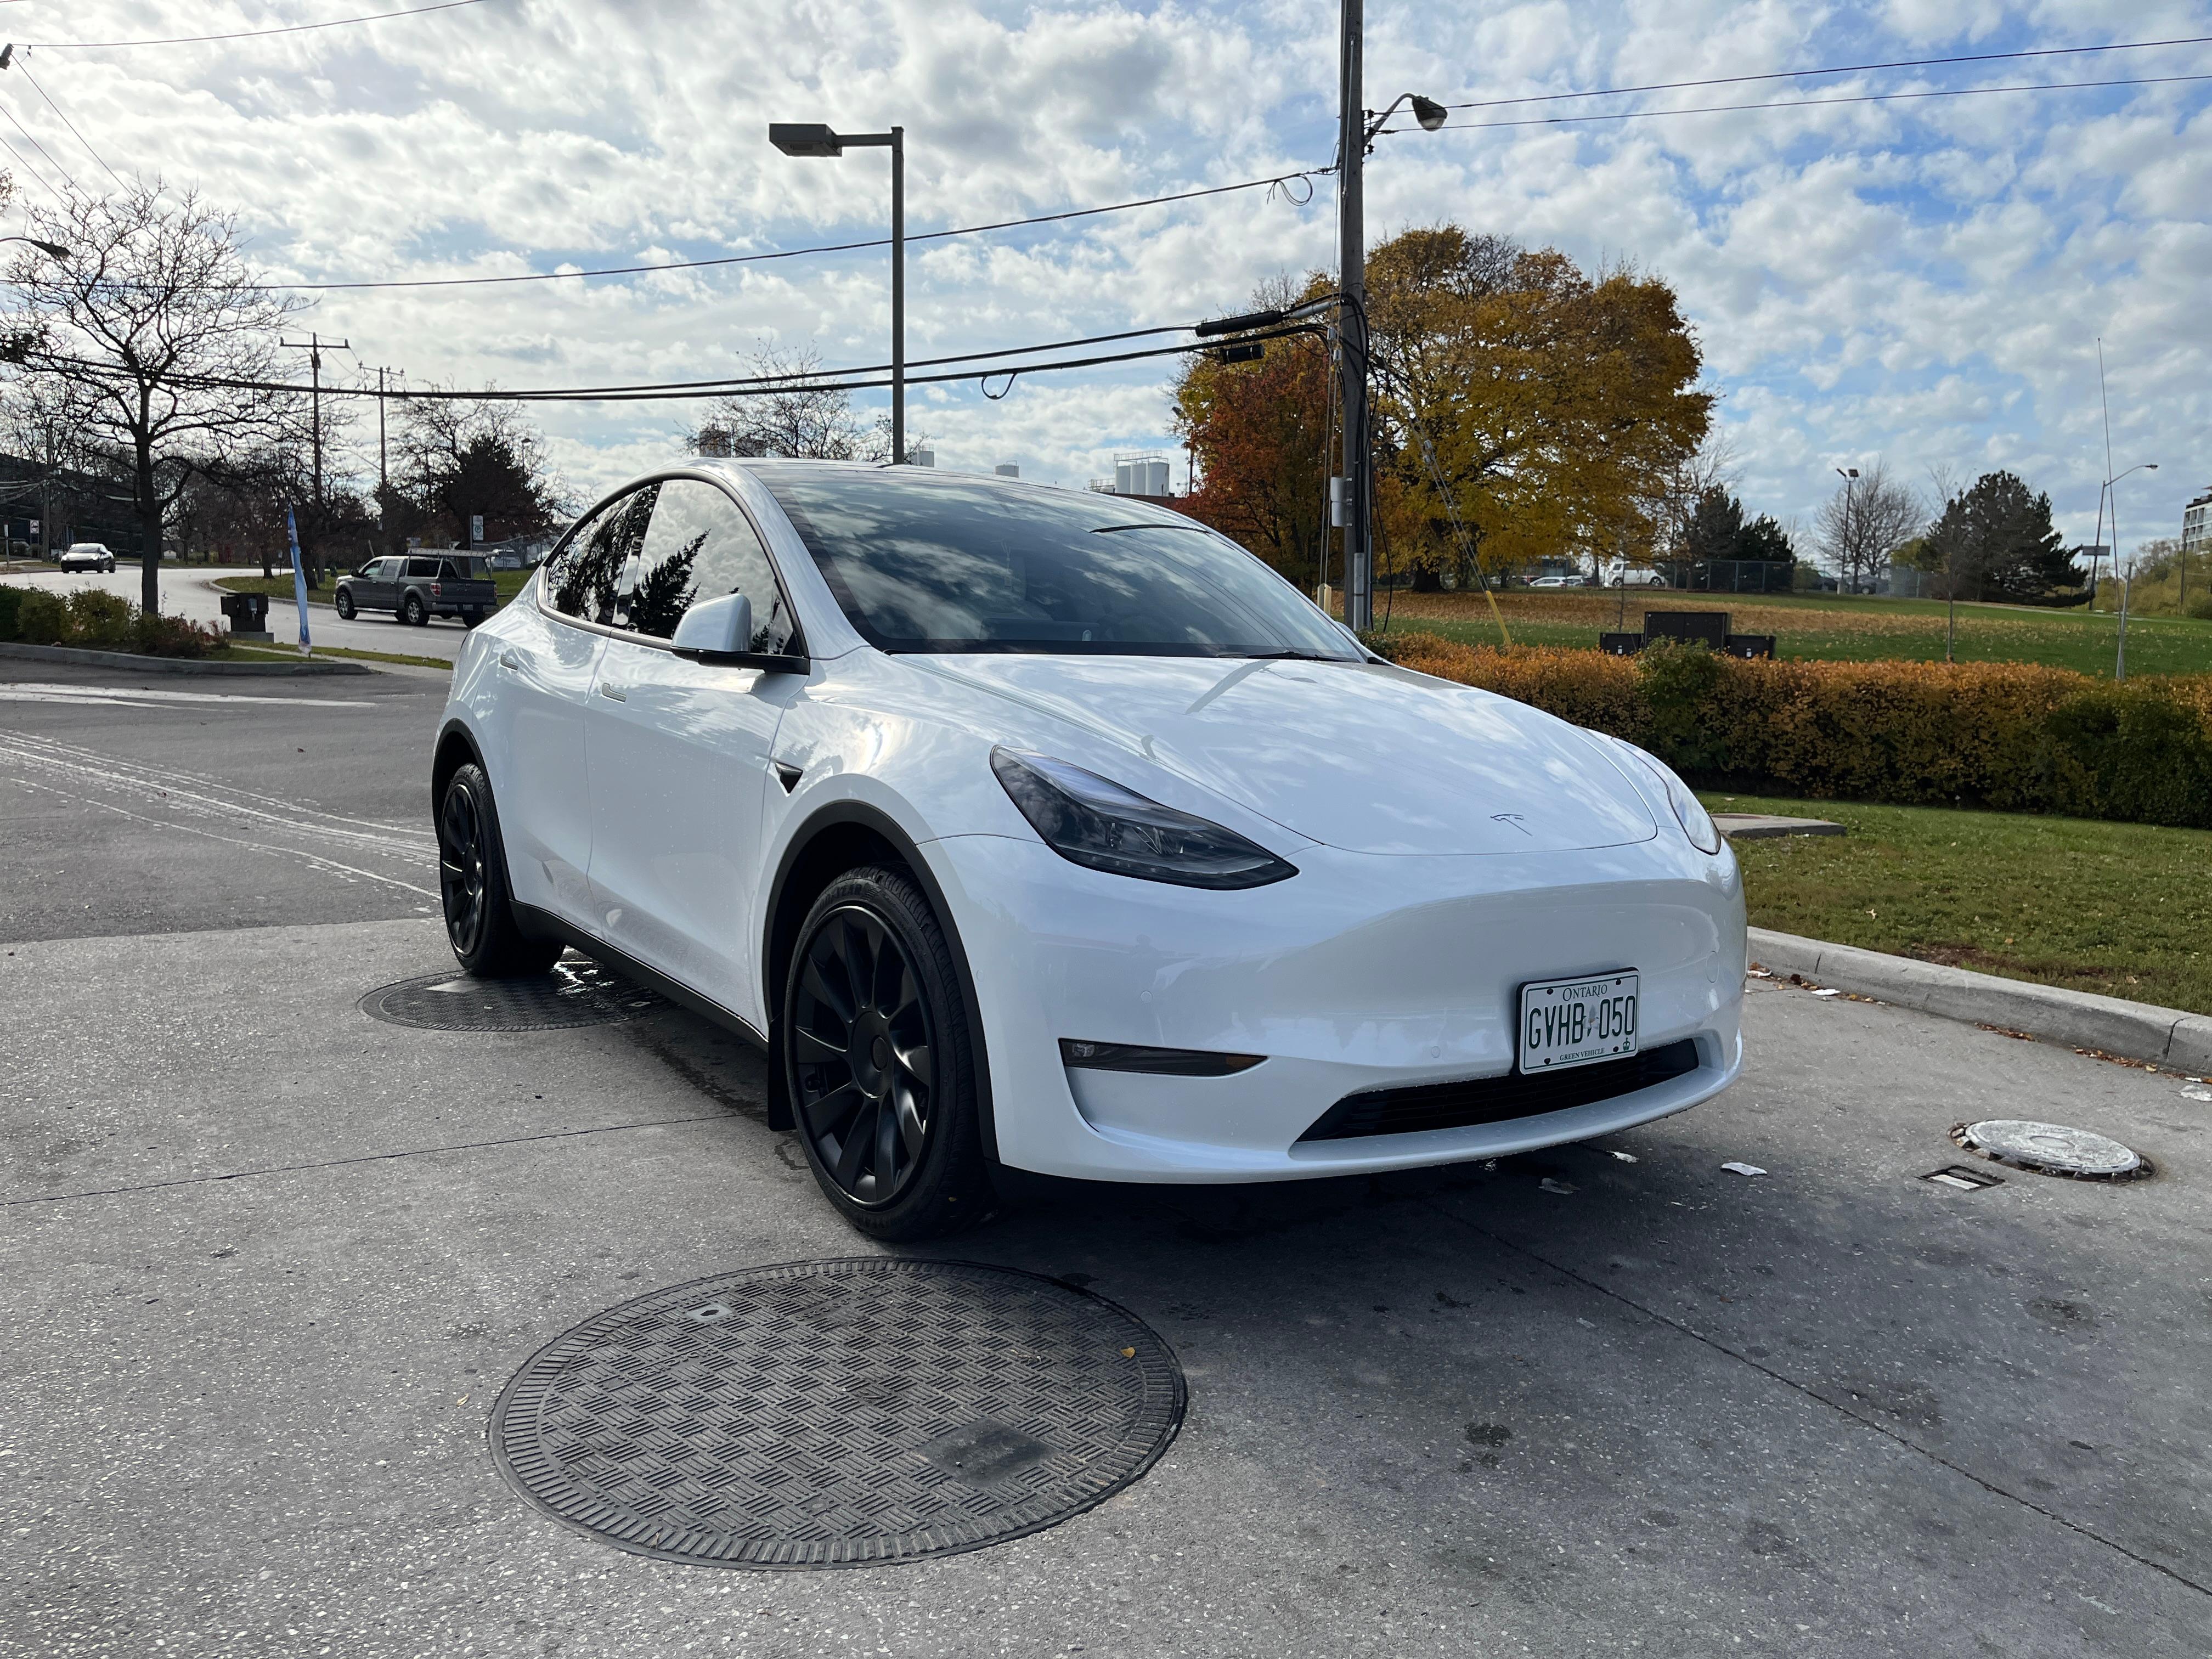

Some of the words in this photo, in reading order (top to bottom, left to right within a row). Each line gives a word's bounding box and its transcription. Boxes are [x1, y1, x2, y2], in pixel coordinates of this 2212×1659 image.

[1562, 984, 1607, 1001] ONTARIO
[1528, 1002, 1584, 1049] GVHB
[1599, 995, 1635, 1039] 050
[1560, 1052, 1581, 1061] GREEN
[1581, 1048, 1605, 1058] VEHICLE
